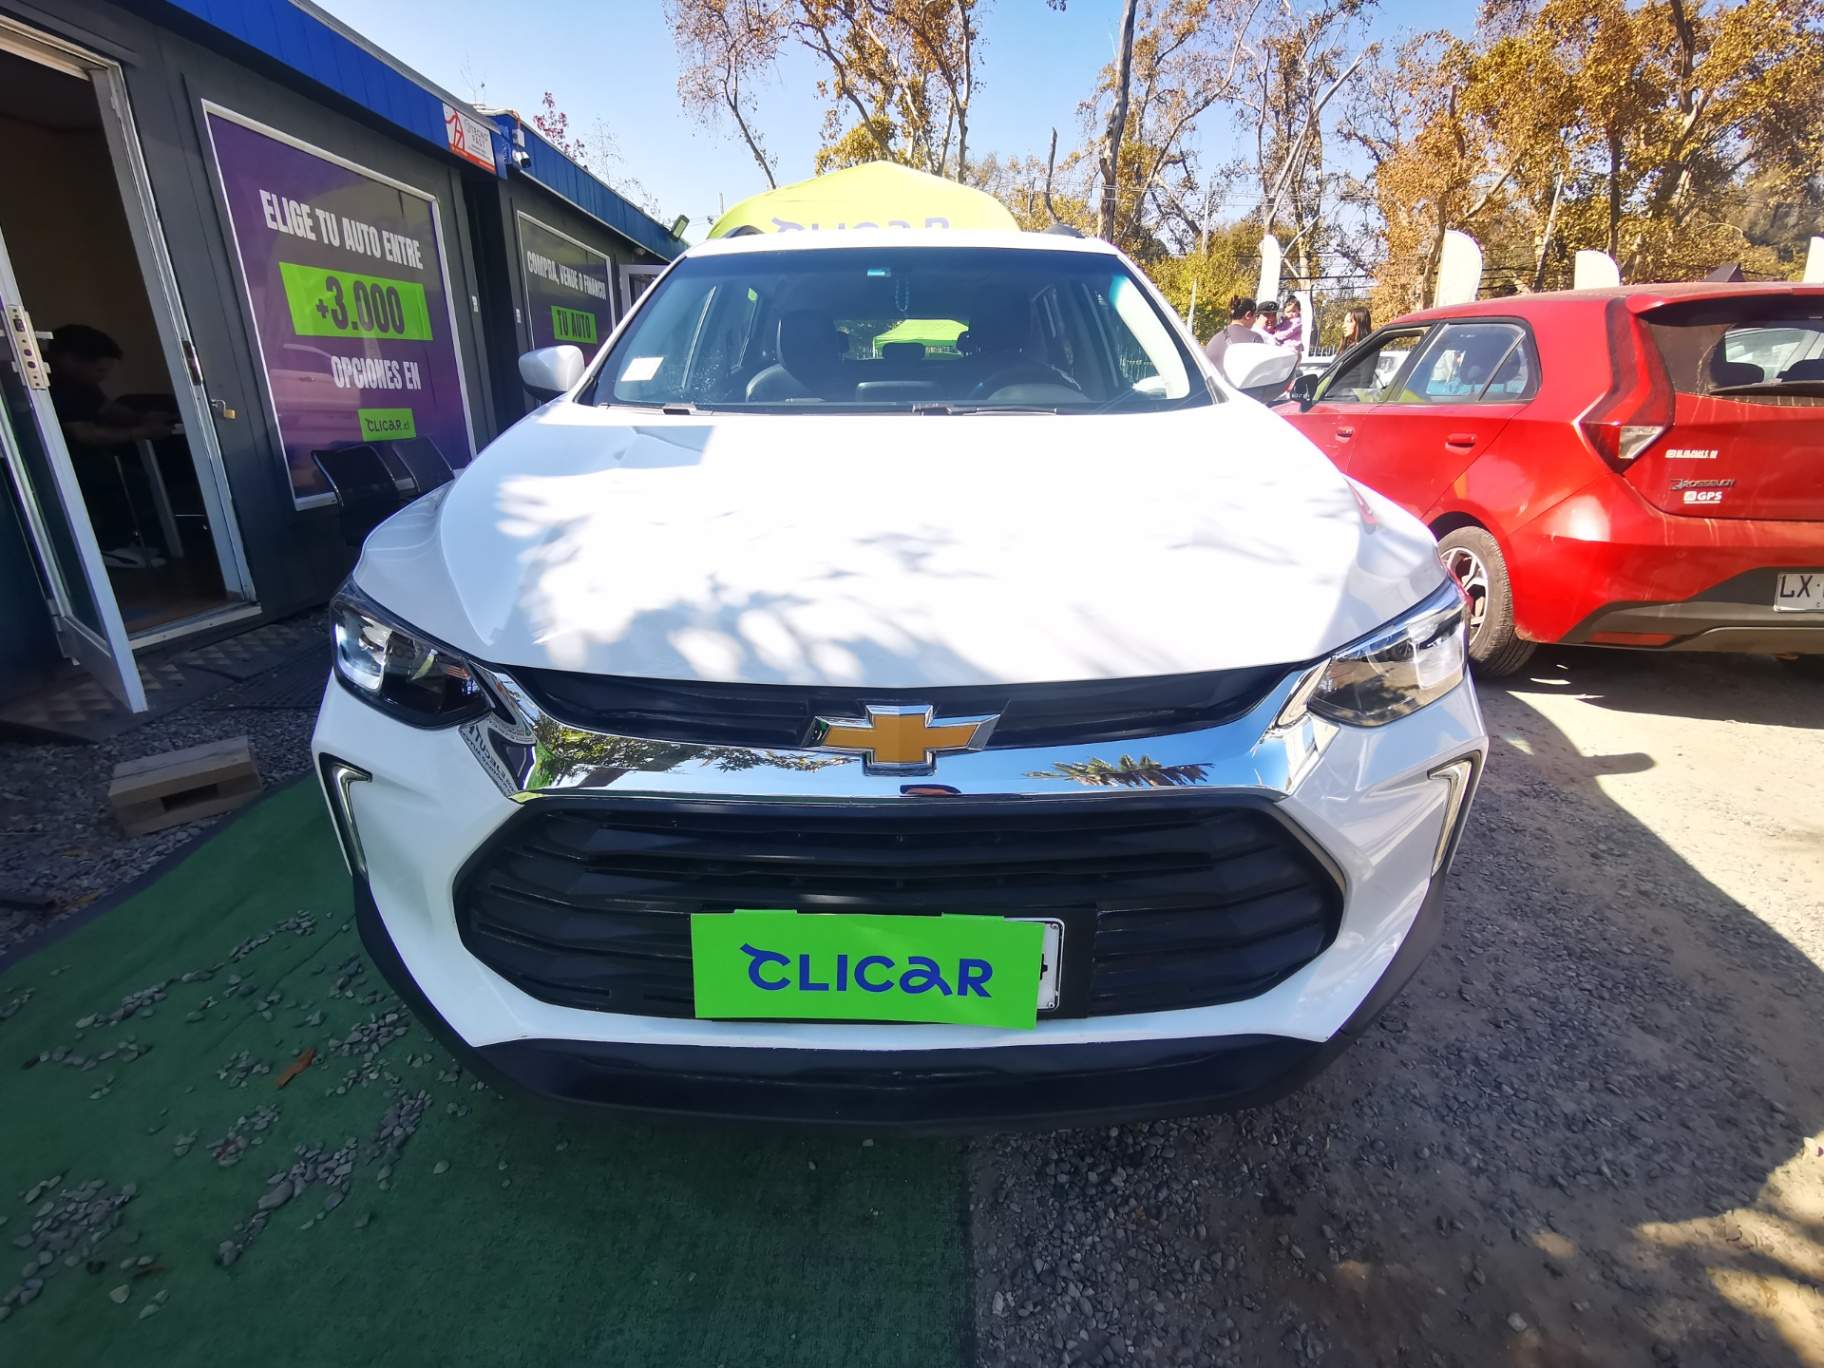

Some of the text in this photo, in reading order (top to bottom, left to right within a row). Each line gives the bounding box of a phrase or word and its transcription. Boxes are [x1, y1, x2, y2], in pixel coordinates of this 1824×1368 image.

[259, 189, 423, 270] ELIGE TU AUTO ENTRE
[316, 276, 405, 334] +3.000
[556, 309, 592, 339] TU AUTO
[331, 356, 421, 390] OPCIONES EN
[1697, 491, 1723, 501] GPS
[1780, 575, 1824, 598] LX
